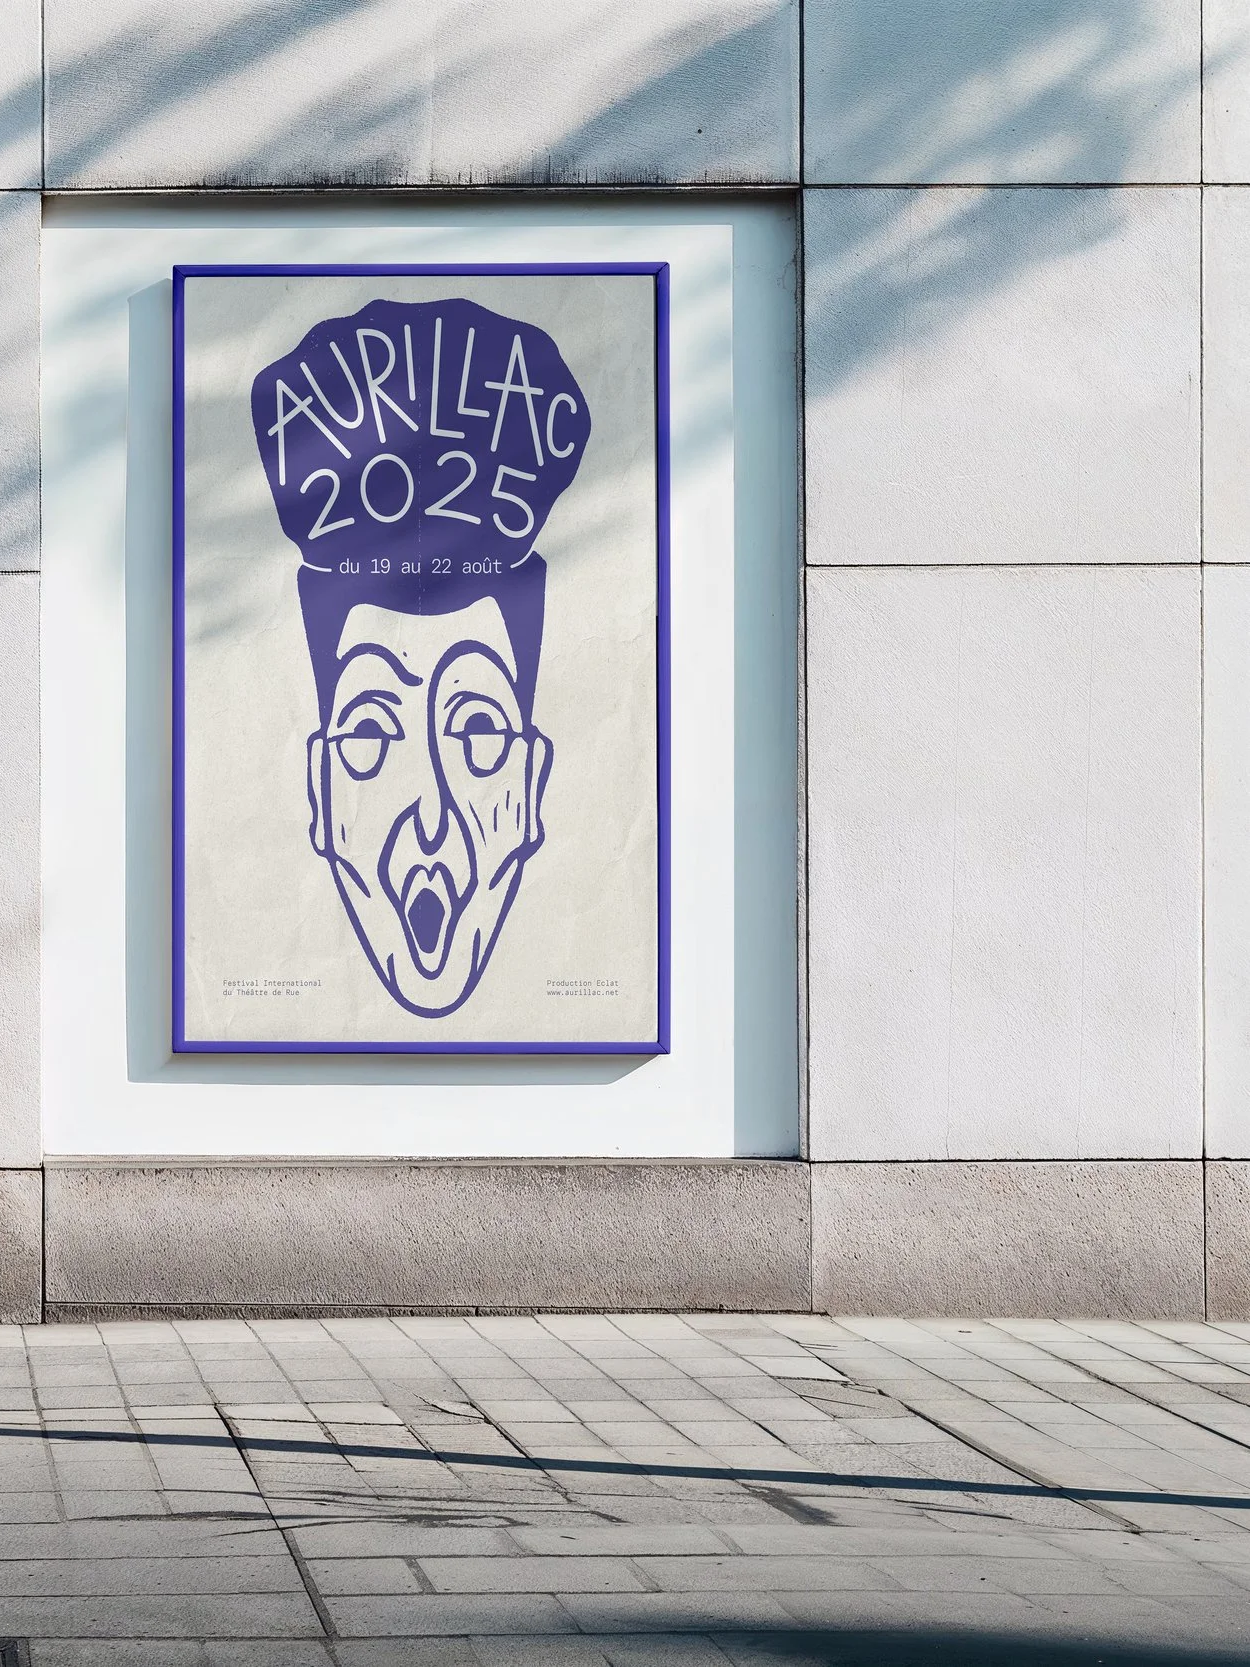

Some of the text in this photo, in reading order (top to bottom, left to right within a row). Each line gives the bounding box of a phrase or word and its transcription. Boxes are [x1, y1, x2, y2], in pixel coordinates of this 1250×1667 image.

[268, 317, 577, 486] AURILLAC
[300, 450, 537, 540] 2025
[339, 556, 502, 574] du 19 au 22 août
[222, 979, 322, 987] Festival International
[546, 979, 619, 987] Production Eclat
[222, 988, 300, 996] du Théâtre de Rue
[546, 988, 619, 996] www.aurillac.net
